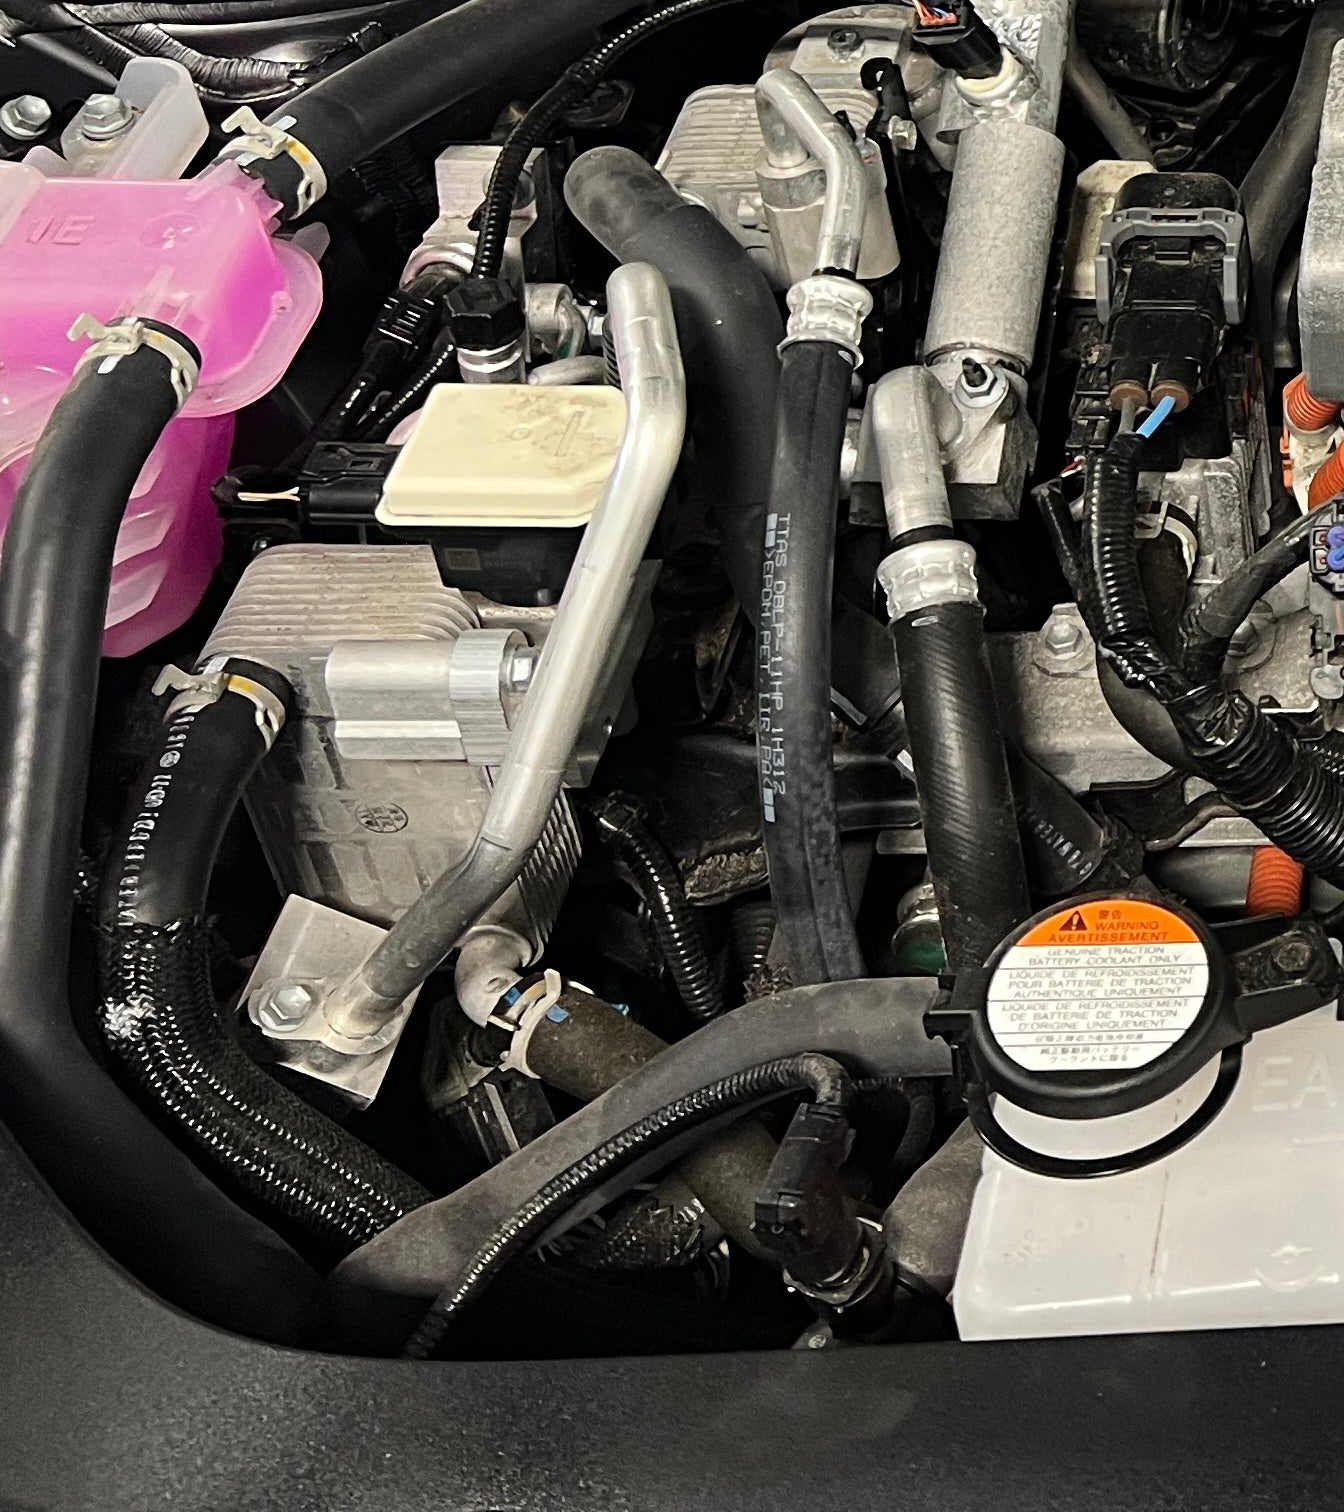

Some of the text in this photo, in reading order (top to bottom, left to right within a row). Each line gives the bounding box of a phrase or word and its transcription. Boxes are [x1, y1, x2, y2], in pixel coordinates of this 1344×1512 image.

[776, 513, 791, 567] TTAS
[771, 727, 786, 795] 1H312
[1095, 921, 1159, 930] WARNING
[1048, 932, 1168, 943] AVERTISSEMENT
[1047, 946, 1165, 956] GENUINE TRACTION
[1028, 955, 1181, 966] BATTERY COOLANT ONLY
[1009, 967, 1194, 979] LIQUIDE DE REFROIDISSEMENT
[1007, 977, 1192, 989] POUR BATTERIE DE TRACTION
[1013, 987, 1183, 998] AUTHENTIQUE UNIQUEMENT
[1001, 999, 1189, 1011] LIQUIDE DE REFROIDISSEMENT
[1010, 1009, 1178, 1021] DE BATTERIE DE TRACTION
[1018, 1019, 1166, 1031] D'ORIGINE UNIQUEMENT
